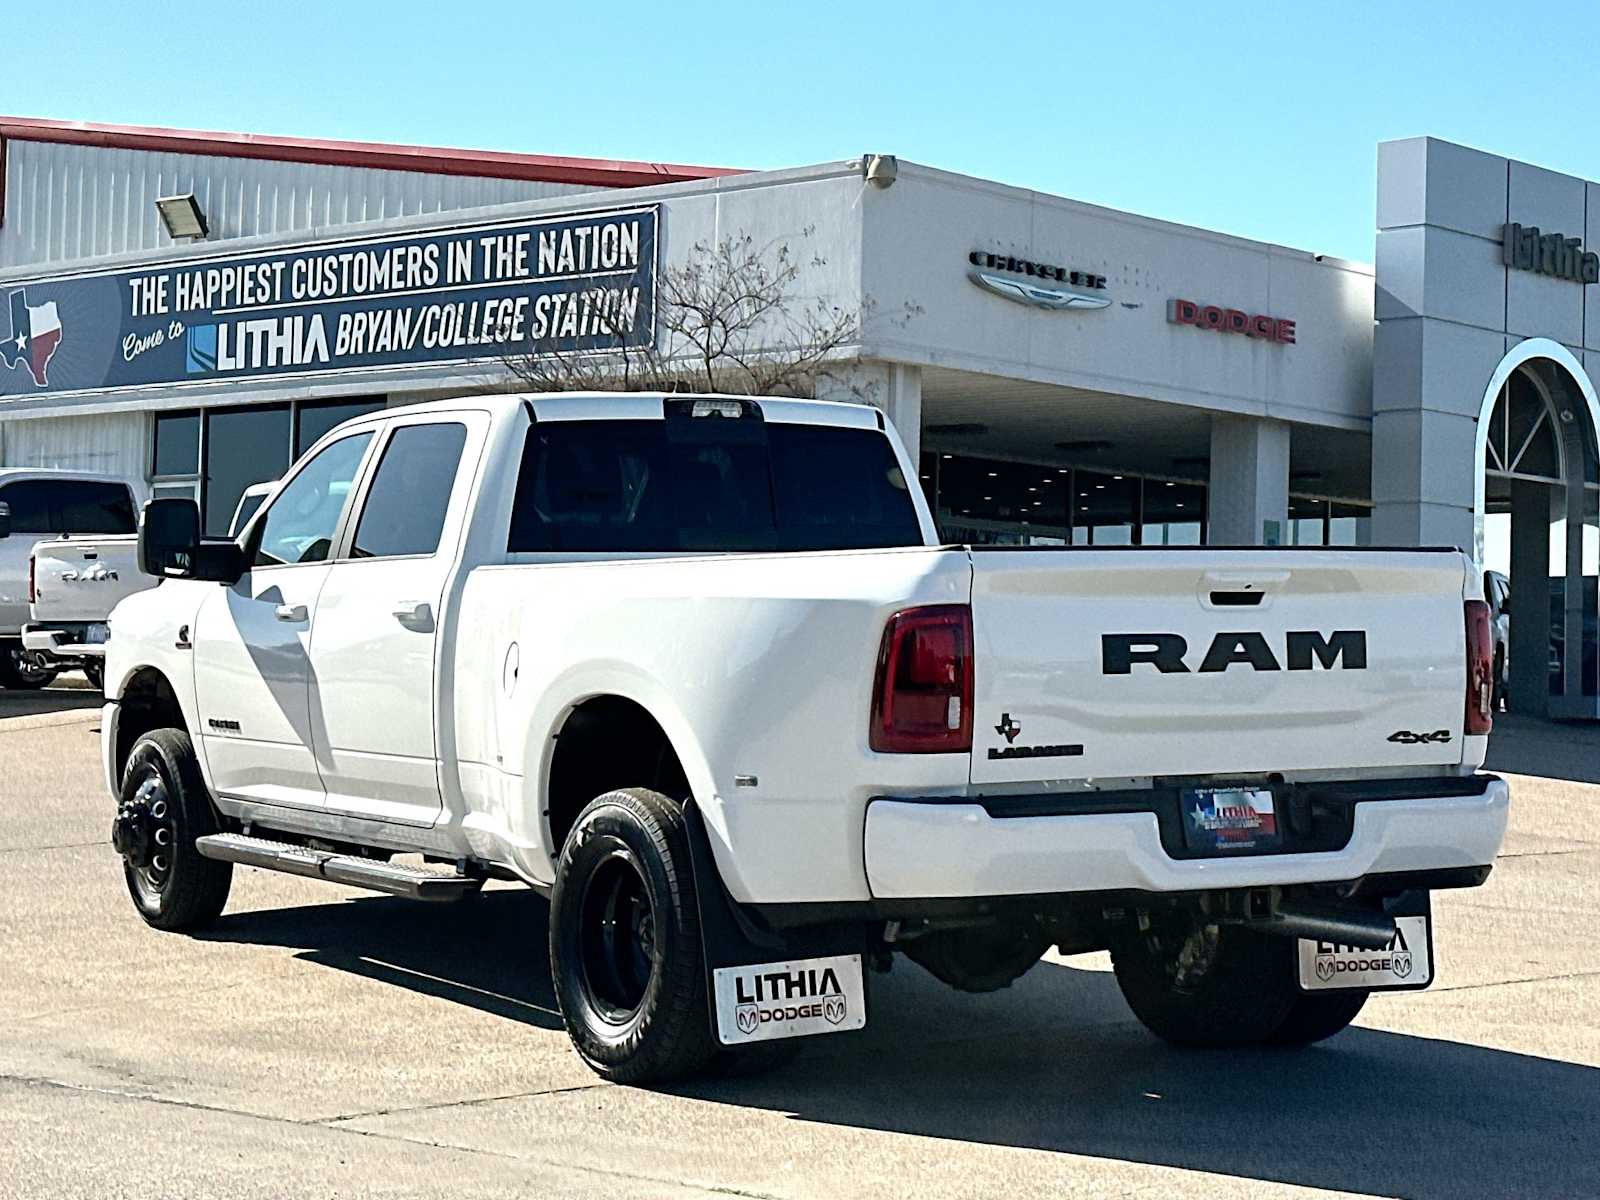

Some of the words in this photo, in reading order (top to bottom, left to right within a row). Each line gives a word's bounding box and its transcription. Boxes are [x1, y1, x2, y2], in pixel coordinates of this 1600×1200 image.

[129, 275, 170, 317] THE
[175, 261, 286, 312] HAPPIEST
[291, 244, 440, 300] CUSTOMERS
[446, 239, 474, 284] IN
[480, 233, 531, 280] THE
[537, 220, 640, 275] NATION
[122, 330, 165, 362] Come
[168, 319, 185, 340] to
[216, 312, 330, 371] LITHIA
[334, 297, 530, 356] BRYAN/COLLEGE
[531, 286, 640, 340] STATION
[1167, 299, 1296, 345] DODGE
[1101, 630, 1367, 675] RAM
[735, 967, 843, 1004] LITHIA
[1336, 958, 1393, 973] DODGE
[759, 1004, 823, 1023] DODGE
